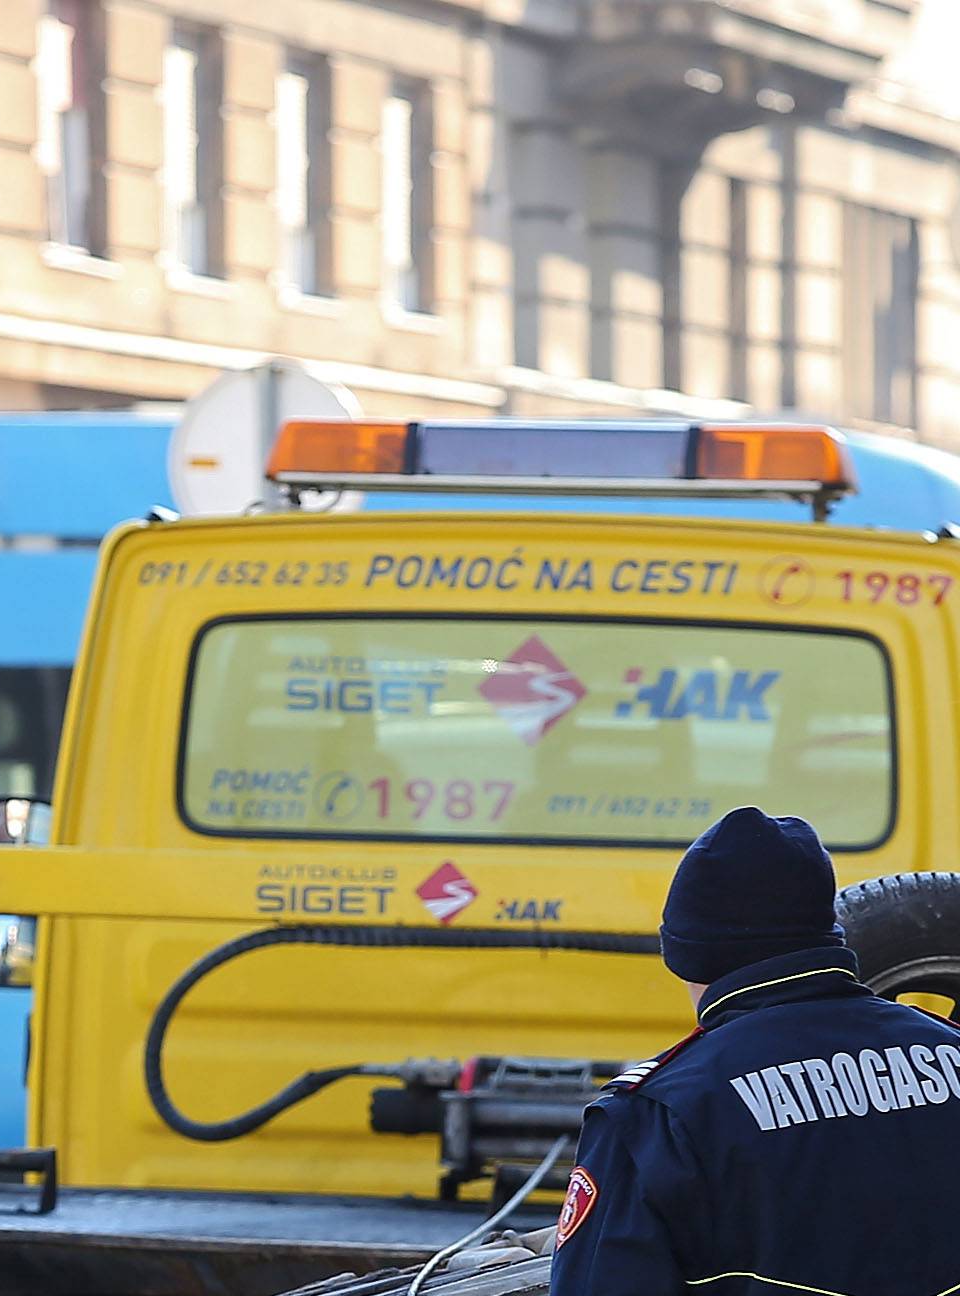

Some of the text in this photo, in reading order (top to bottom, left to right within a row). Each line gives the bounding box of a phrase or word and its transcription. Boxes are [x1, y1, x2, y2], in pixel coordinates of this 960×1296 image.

[140, 560, 186, 587] 091
[273, 560, 310, 587] 62
[364, 546, 525, 591] POMOĆ
[533, 558, 595, 593] NA
[609, 559, 739, 595] CESTI
[835, 569, 954, 607] 1987
[285, 676, 446, 714] SIGET
[211, 767, 311, 794] POMOĆ
[369, 777, 516, 821] 1987
[258, 864, 398, 881] AUTOKLUB
[256, 884, 395, 915] SIGET
[729, 1044, 960, 1132] VATROGASC
